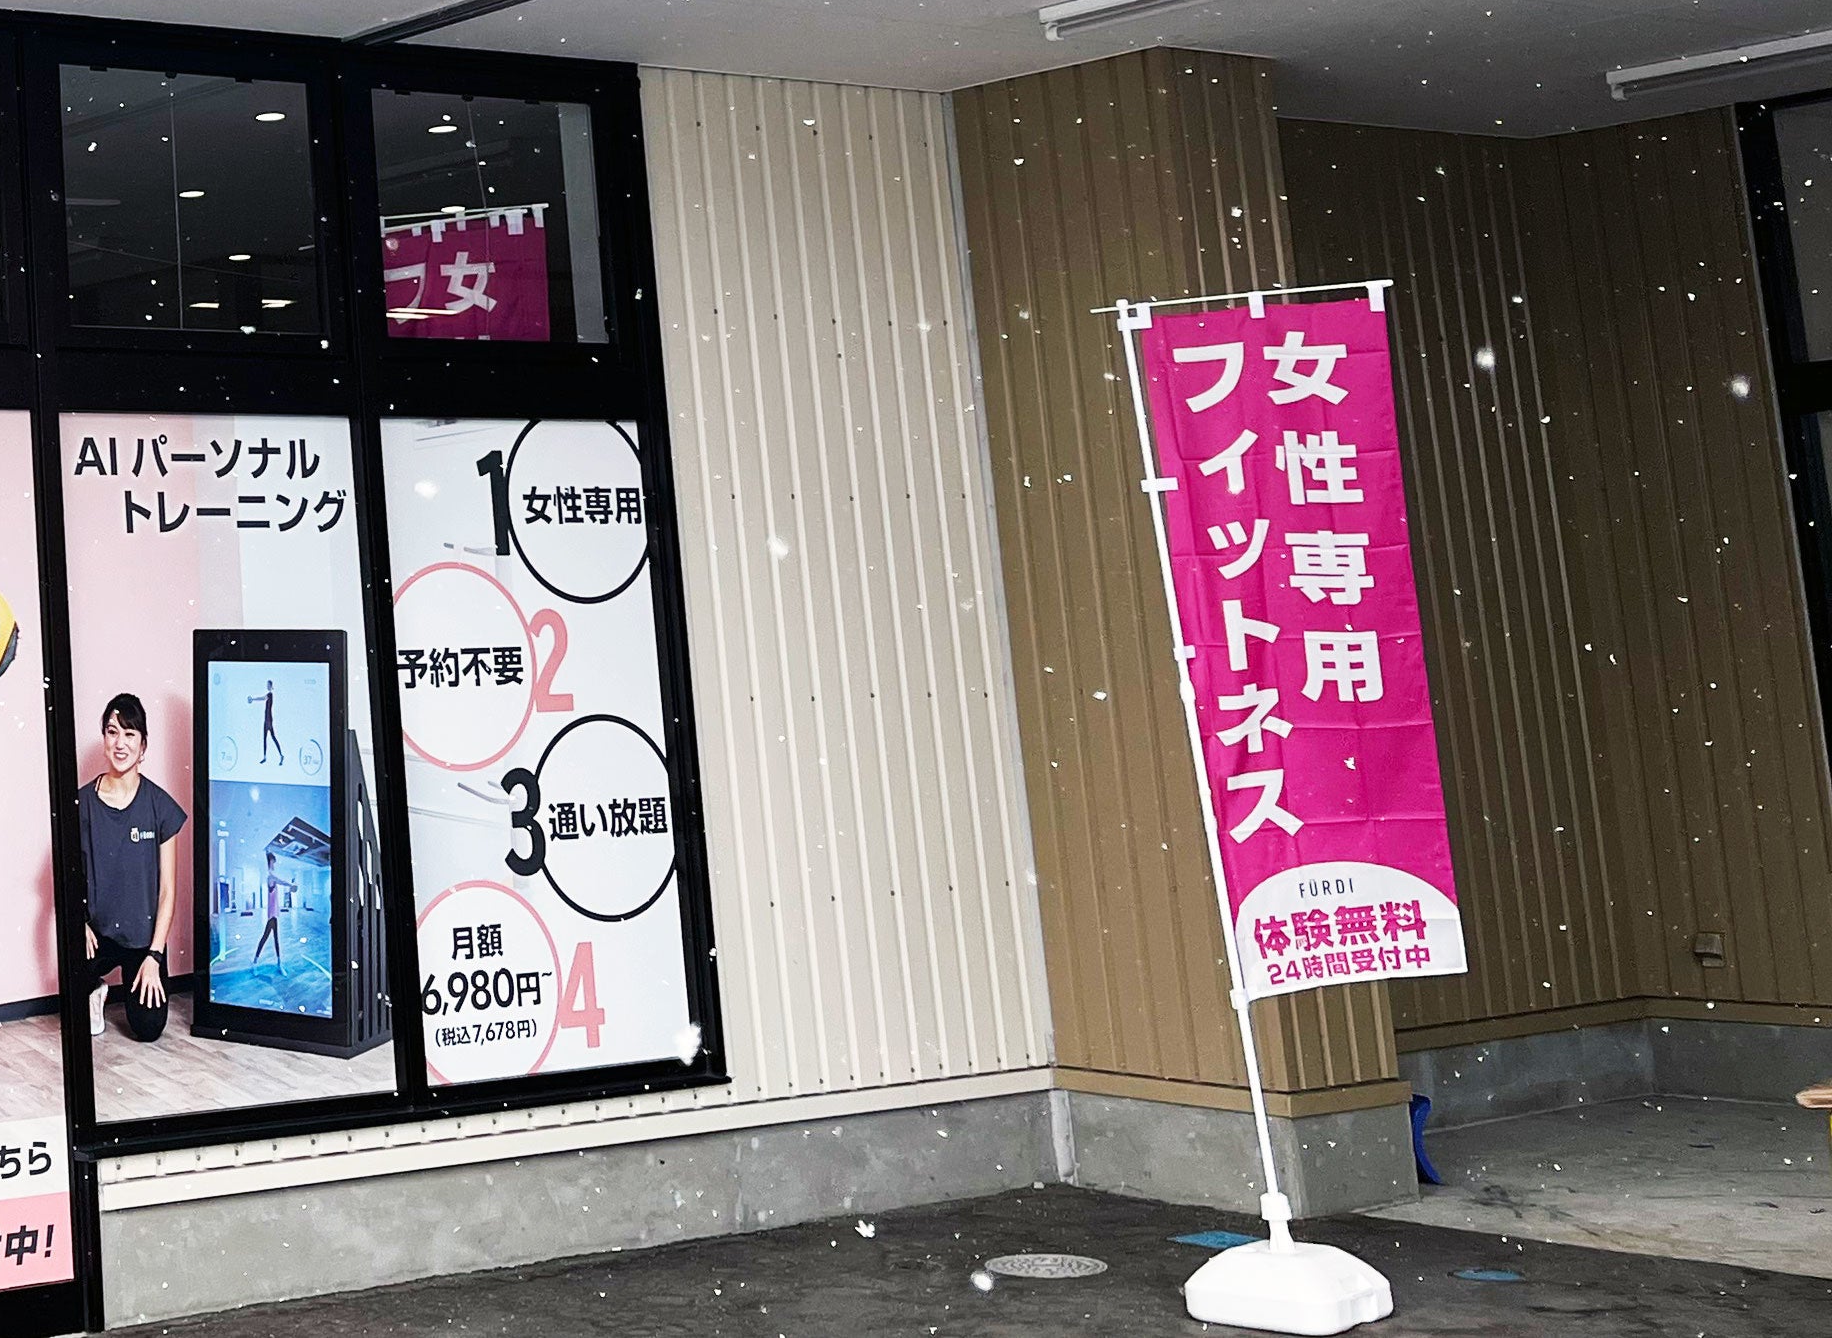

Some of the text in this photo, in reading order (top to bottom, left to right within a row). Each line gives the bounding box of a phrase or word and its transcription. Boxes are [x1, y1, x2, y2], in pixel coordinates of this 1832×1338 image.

[124, 489, 347, 534] トレーニング
[476, 450, 510, 556] 1
[522, 485, 642, 525] 女性専用
[1263, 331, 1385, 703] 女性専用
[1172, 342, 1305, 844] フィットネス
[397, 646, 524, 689] 予約不要
[529, 608, 575, 713] 2
[500, 767, 546, 876] 3
[548, 796, 668, 841] 通い放題
[1298, 878, 1354, 898] FÜRDI
[451, 923, 504, 960] 月額
[1254, 900, 1427, 960] 体験無料
[1267, 944, 1431, 985] 24時間受付中
[559, 941, 605, 1049] 4
[435, 1018, 537, 1048] (税込7,678円)
